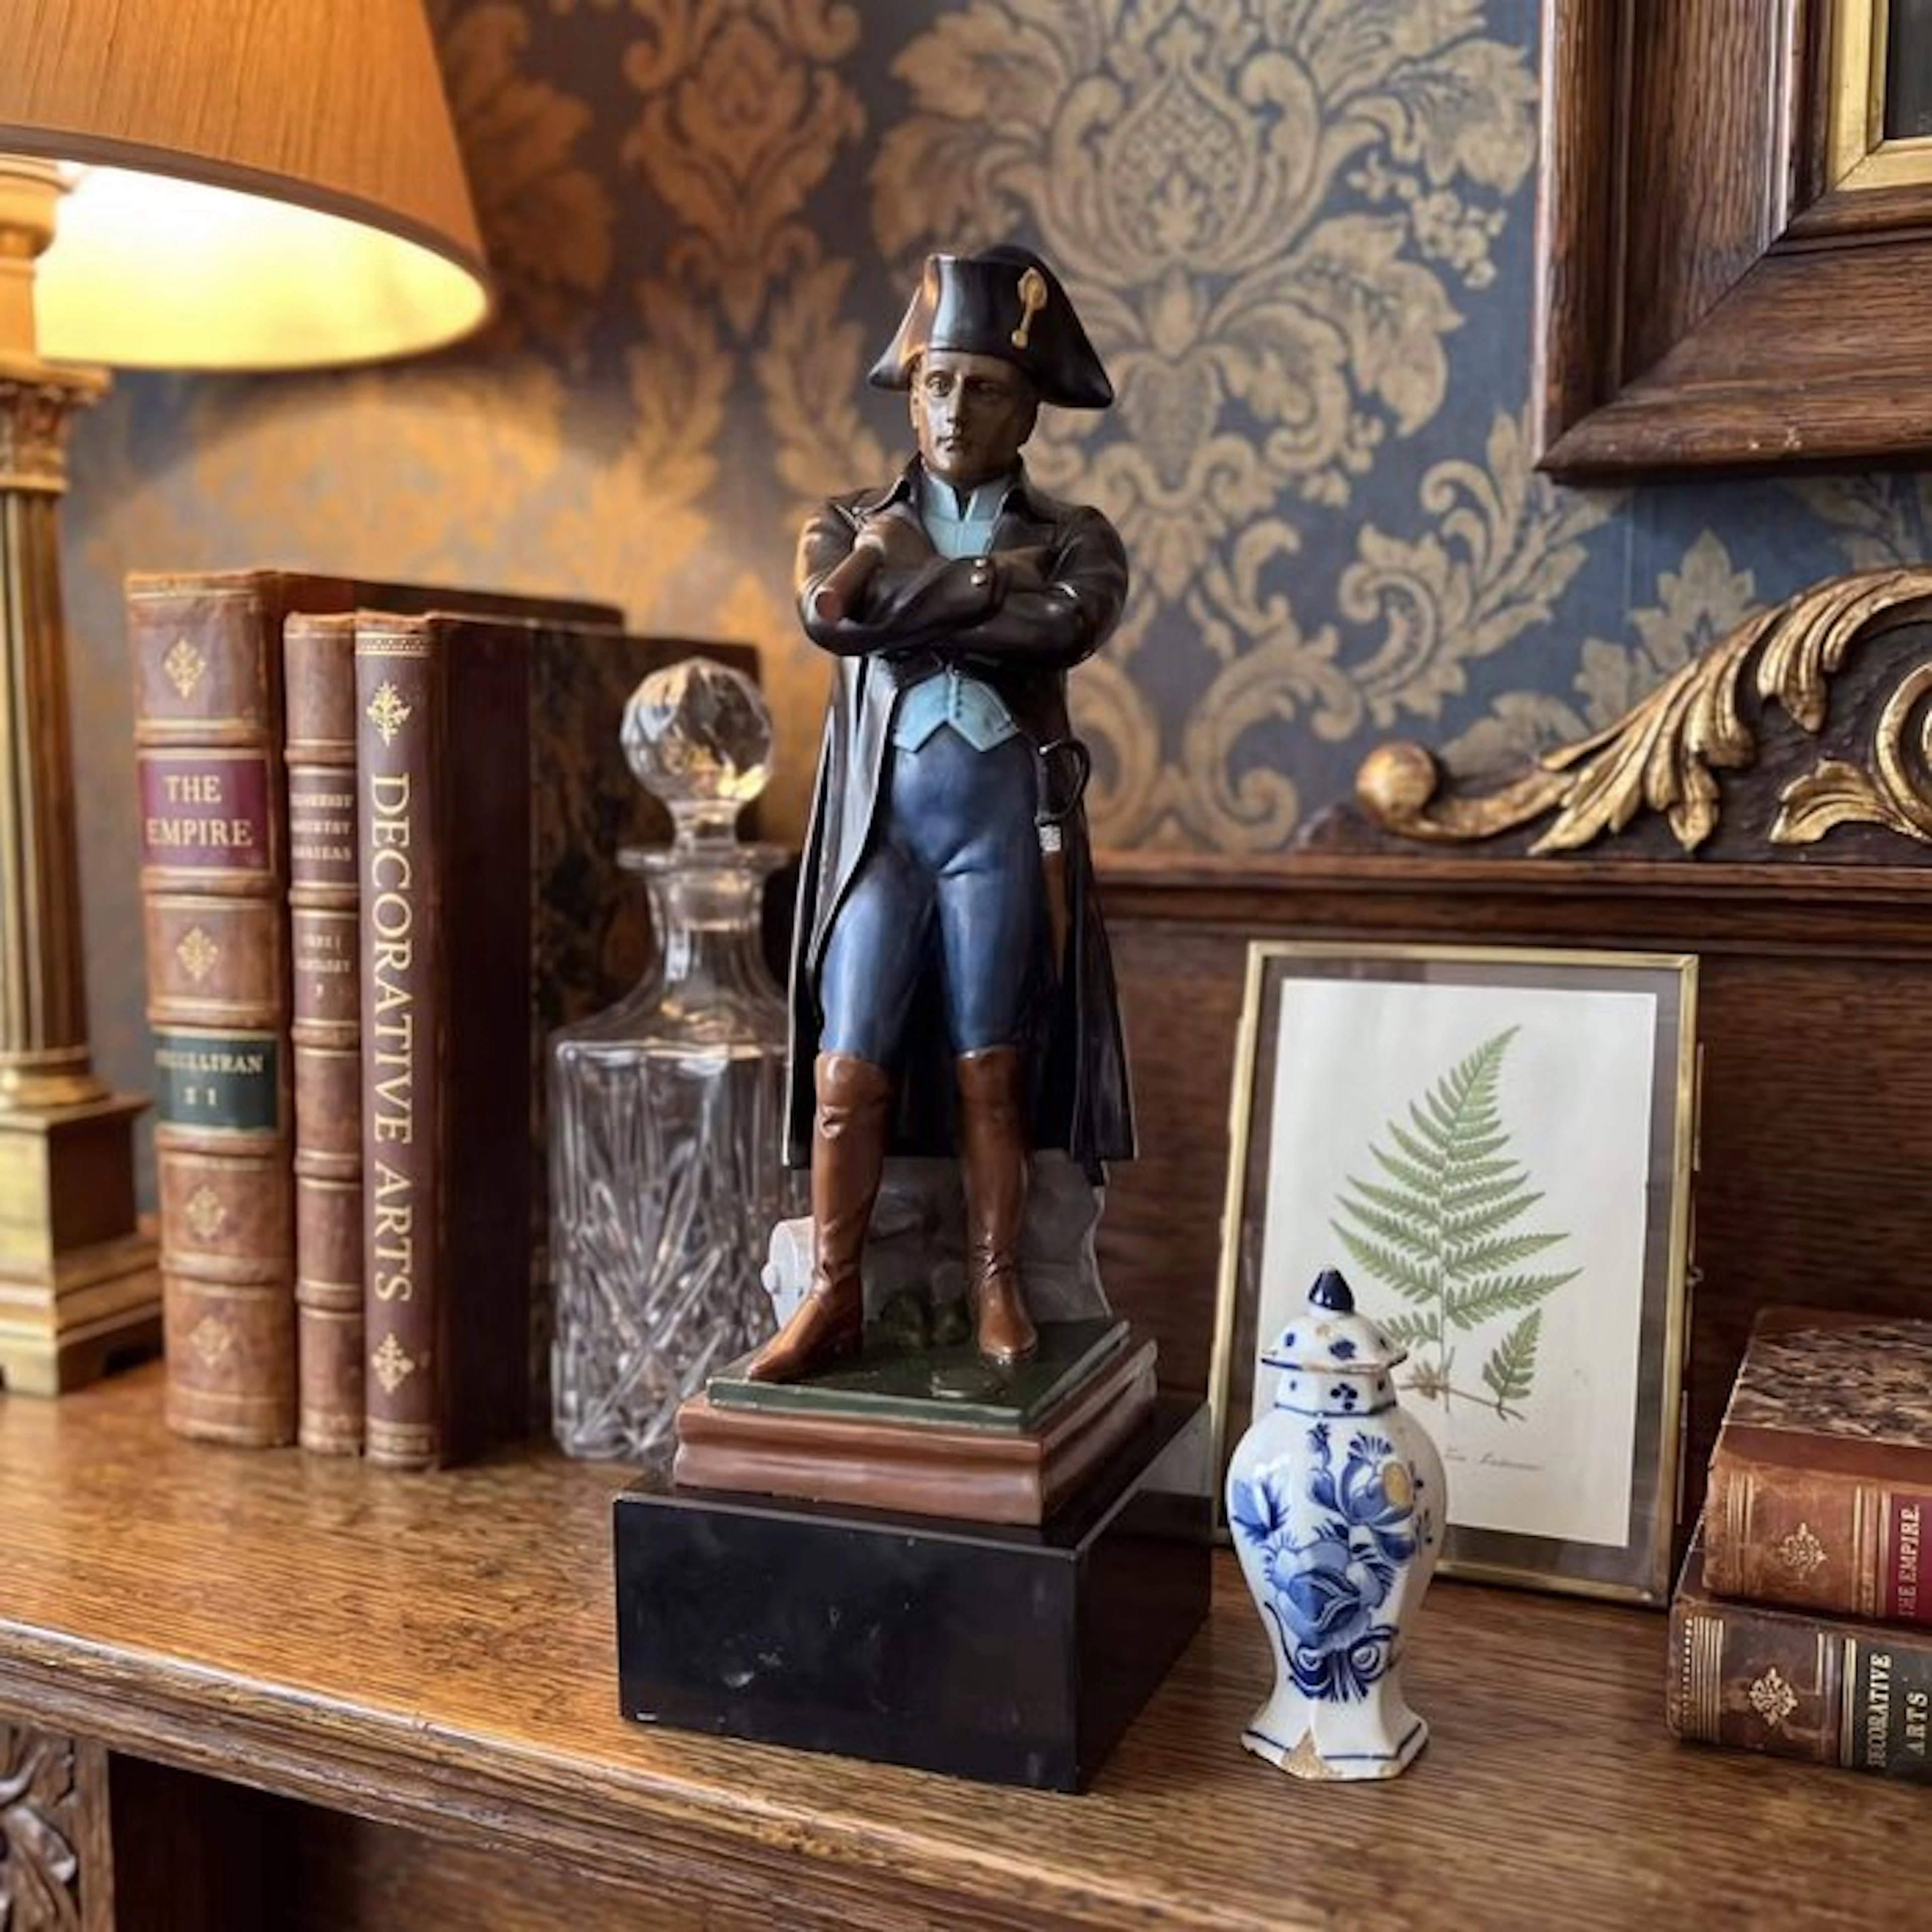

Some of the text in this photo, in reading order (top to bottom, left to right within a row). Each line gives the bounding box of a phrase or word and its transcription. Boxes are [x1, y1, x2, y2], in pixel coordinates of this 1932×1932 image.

[164, 774, 222, 803] THE
[145, 817, 253, 847] EMPIRE
[371, 772, 413, 1301] DECORATIVE ARTS
[1898, 1504, 1920, 1582] EMPIRE
[1905, 1692, 1928, 1757] ARTS
